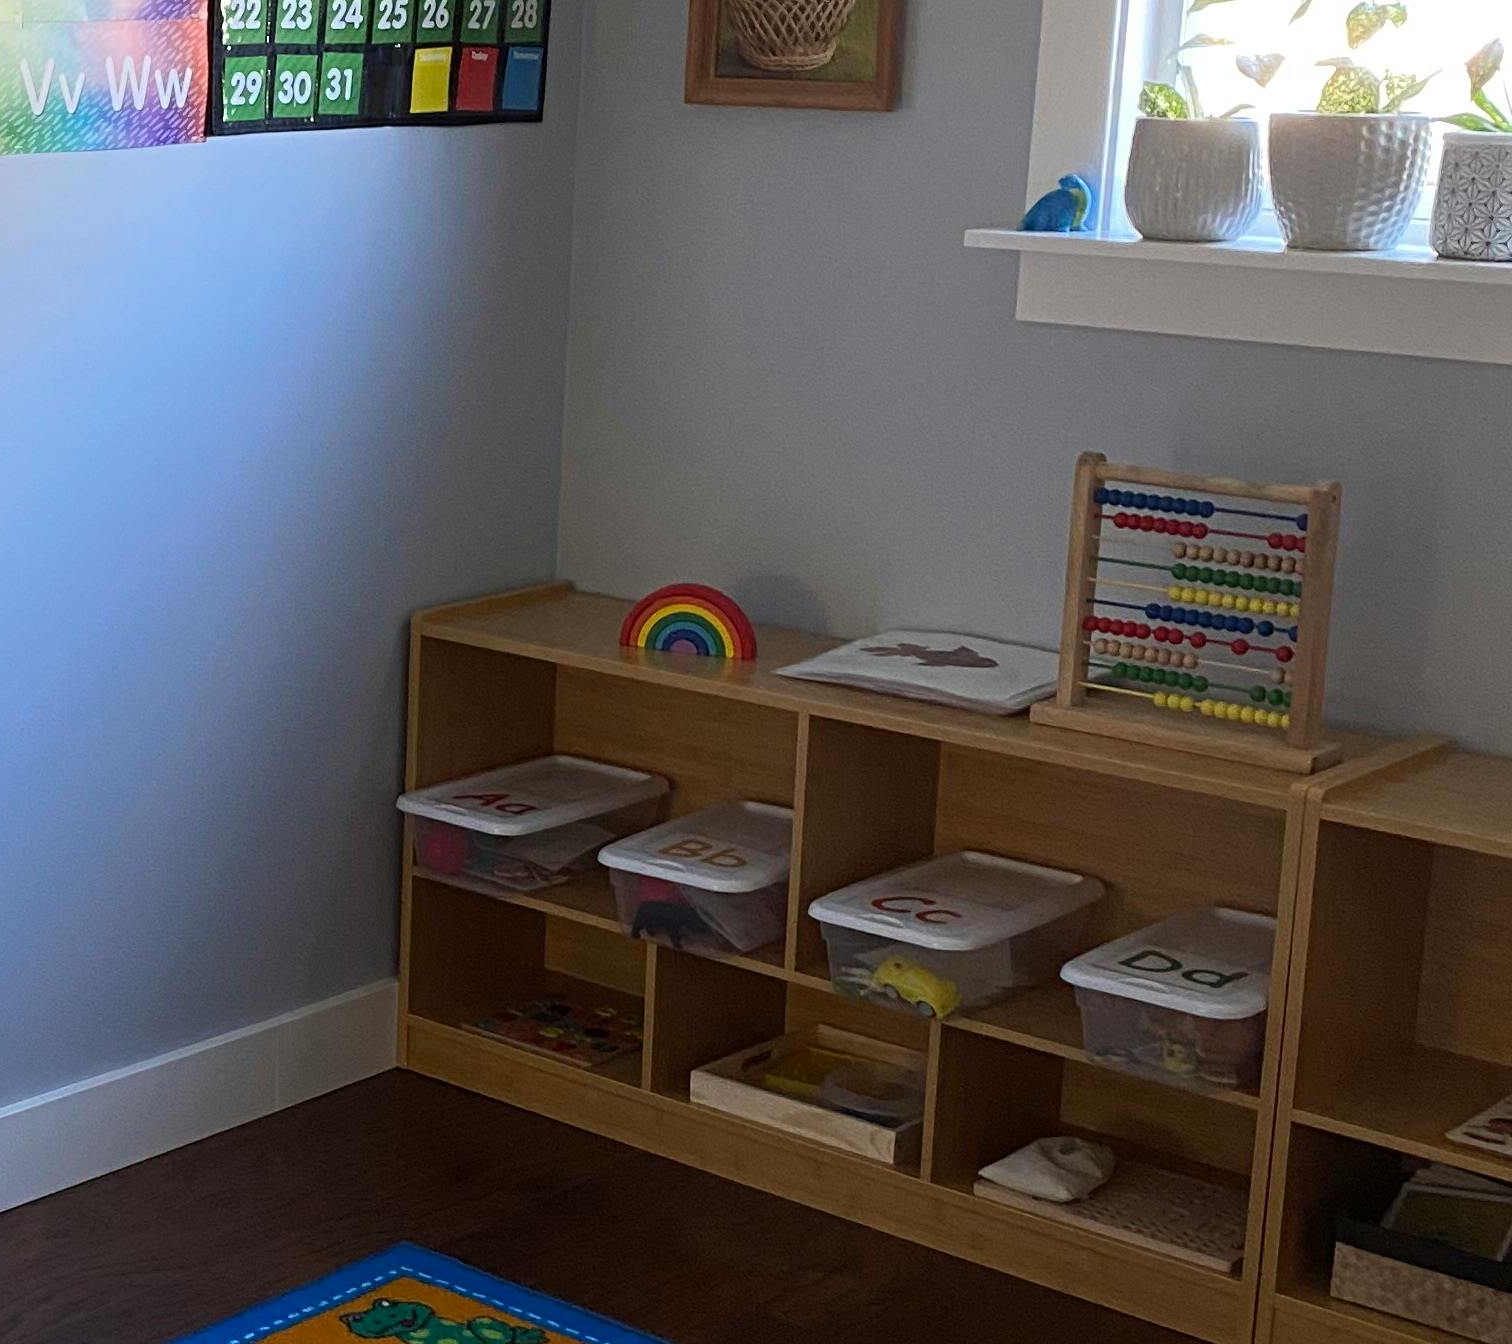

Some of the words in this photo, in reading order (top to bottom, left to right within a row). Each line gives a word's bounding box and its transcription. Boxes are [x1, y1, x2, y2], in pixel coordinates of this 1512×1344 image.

[325, 68, 353, 101] 31
[871, 895, 961, 924] Cc
[1118, 950, 1251, 988] Dd
